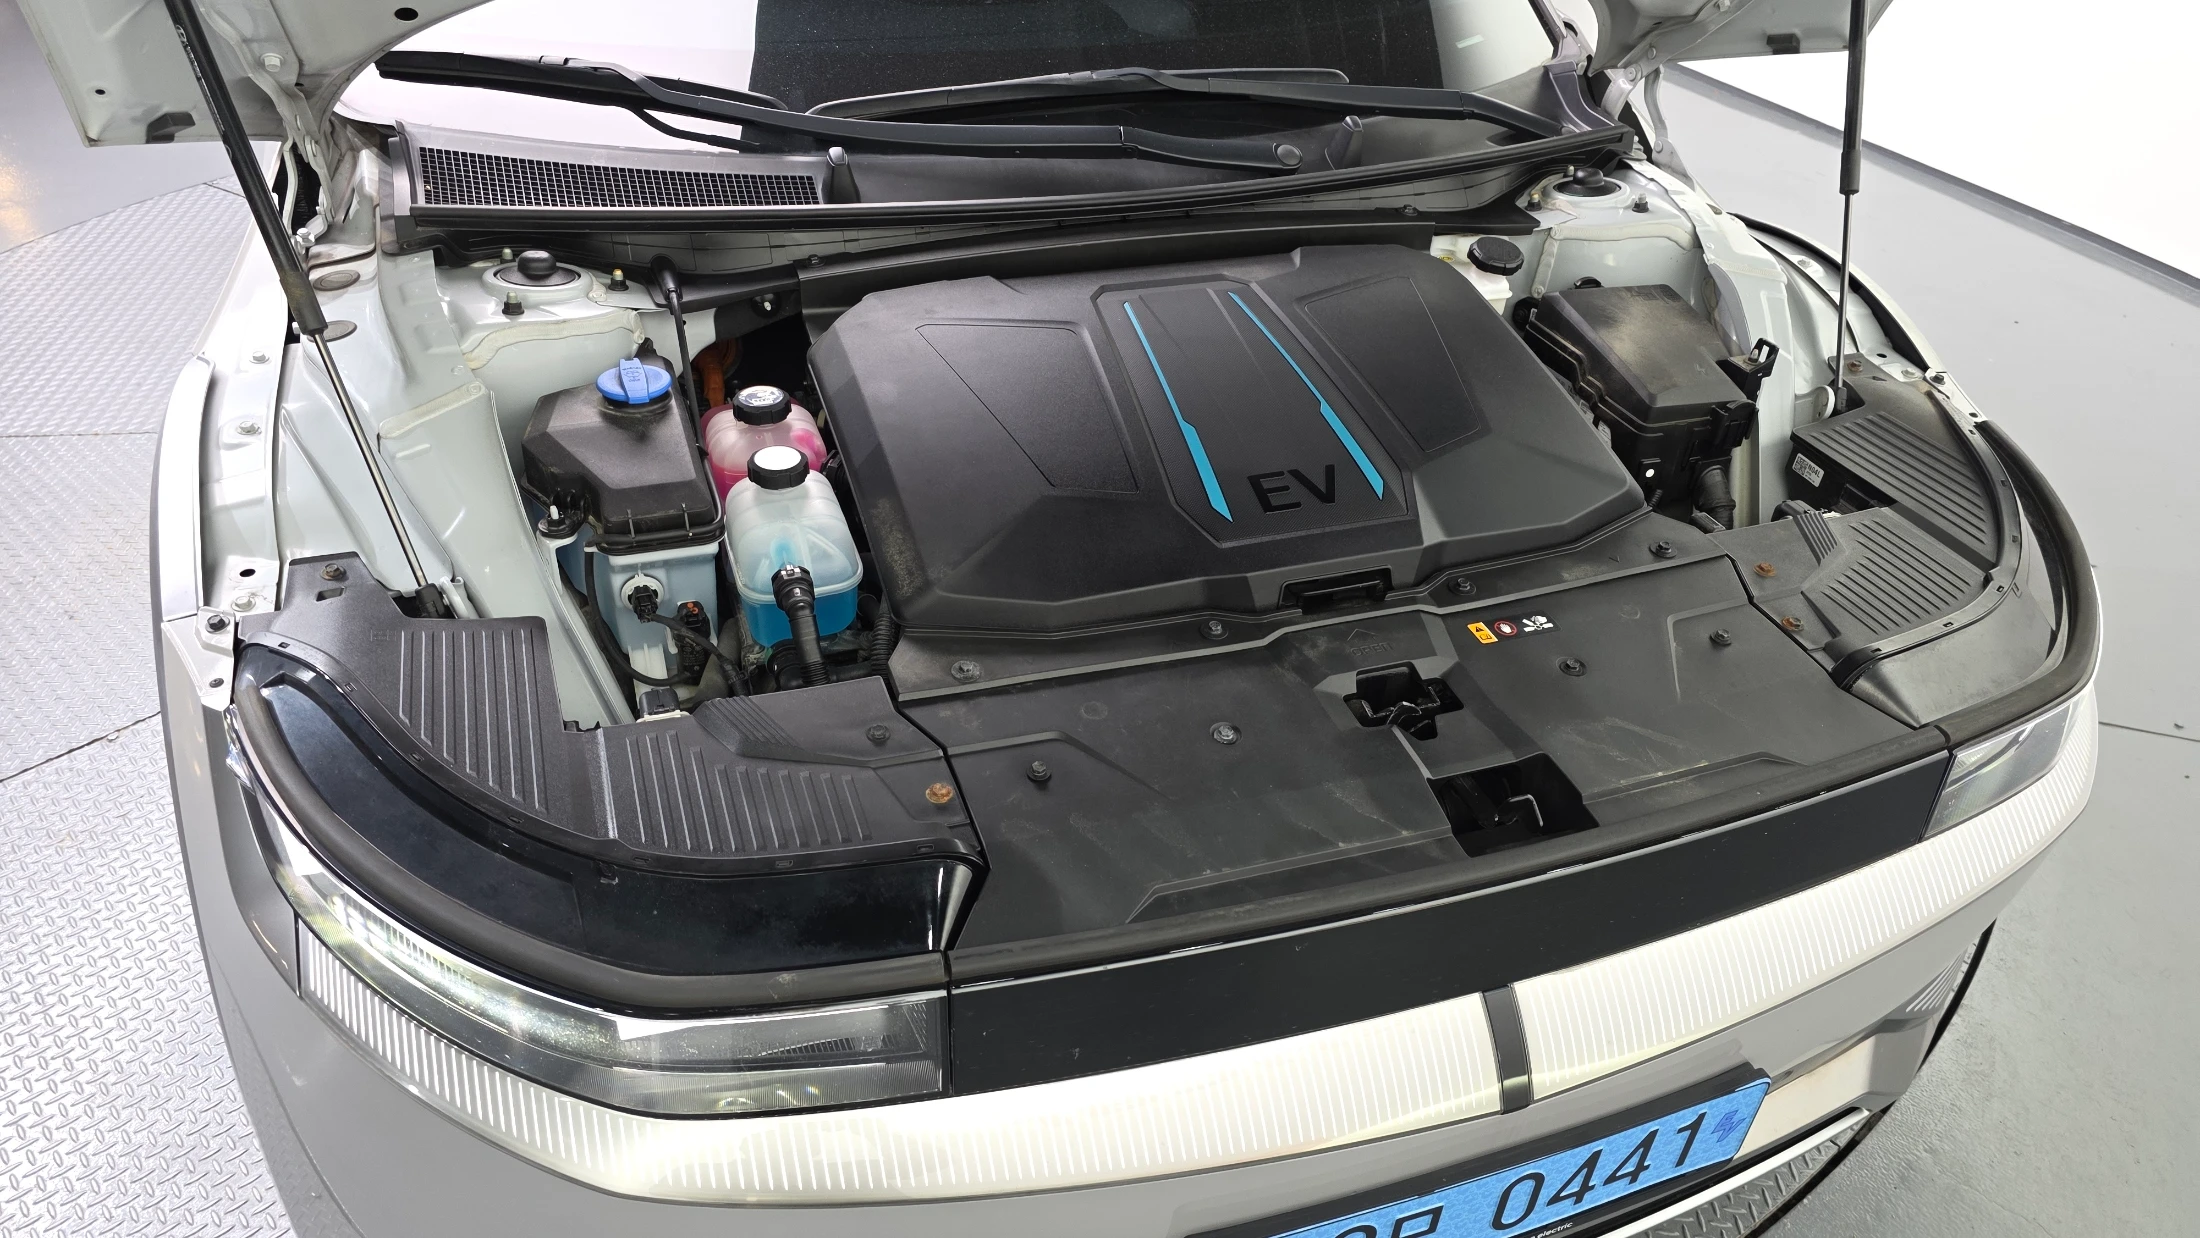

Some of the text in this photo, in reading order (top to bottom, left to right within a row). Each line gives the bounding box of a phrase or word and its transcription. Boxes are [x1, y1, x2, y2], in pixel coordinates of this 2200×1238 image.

[1246, 464, 1335, 514] EV
[1491, 1111, 1707, 1231] 0441
[1537, 1222, 1573, 1238] electric
